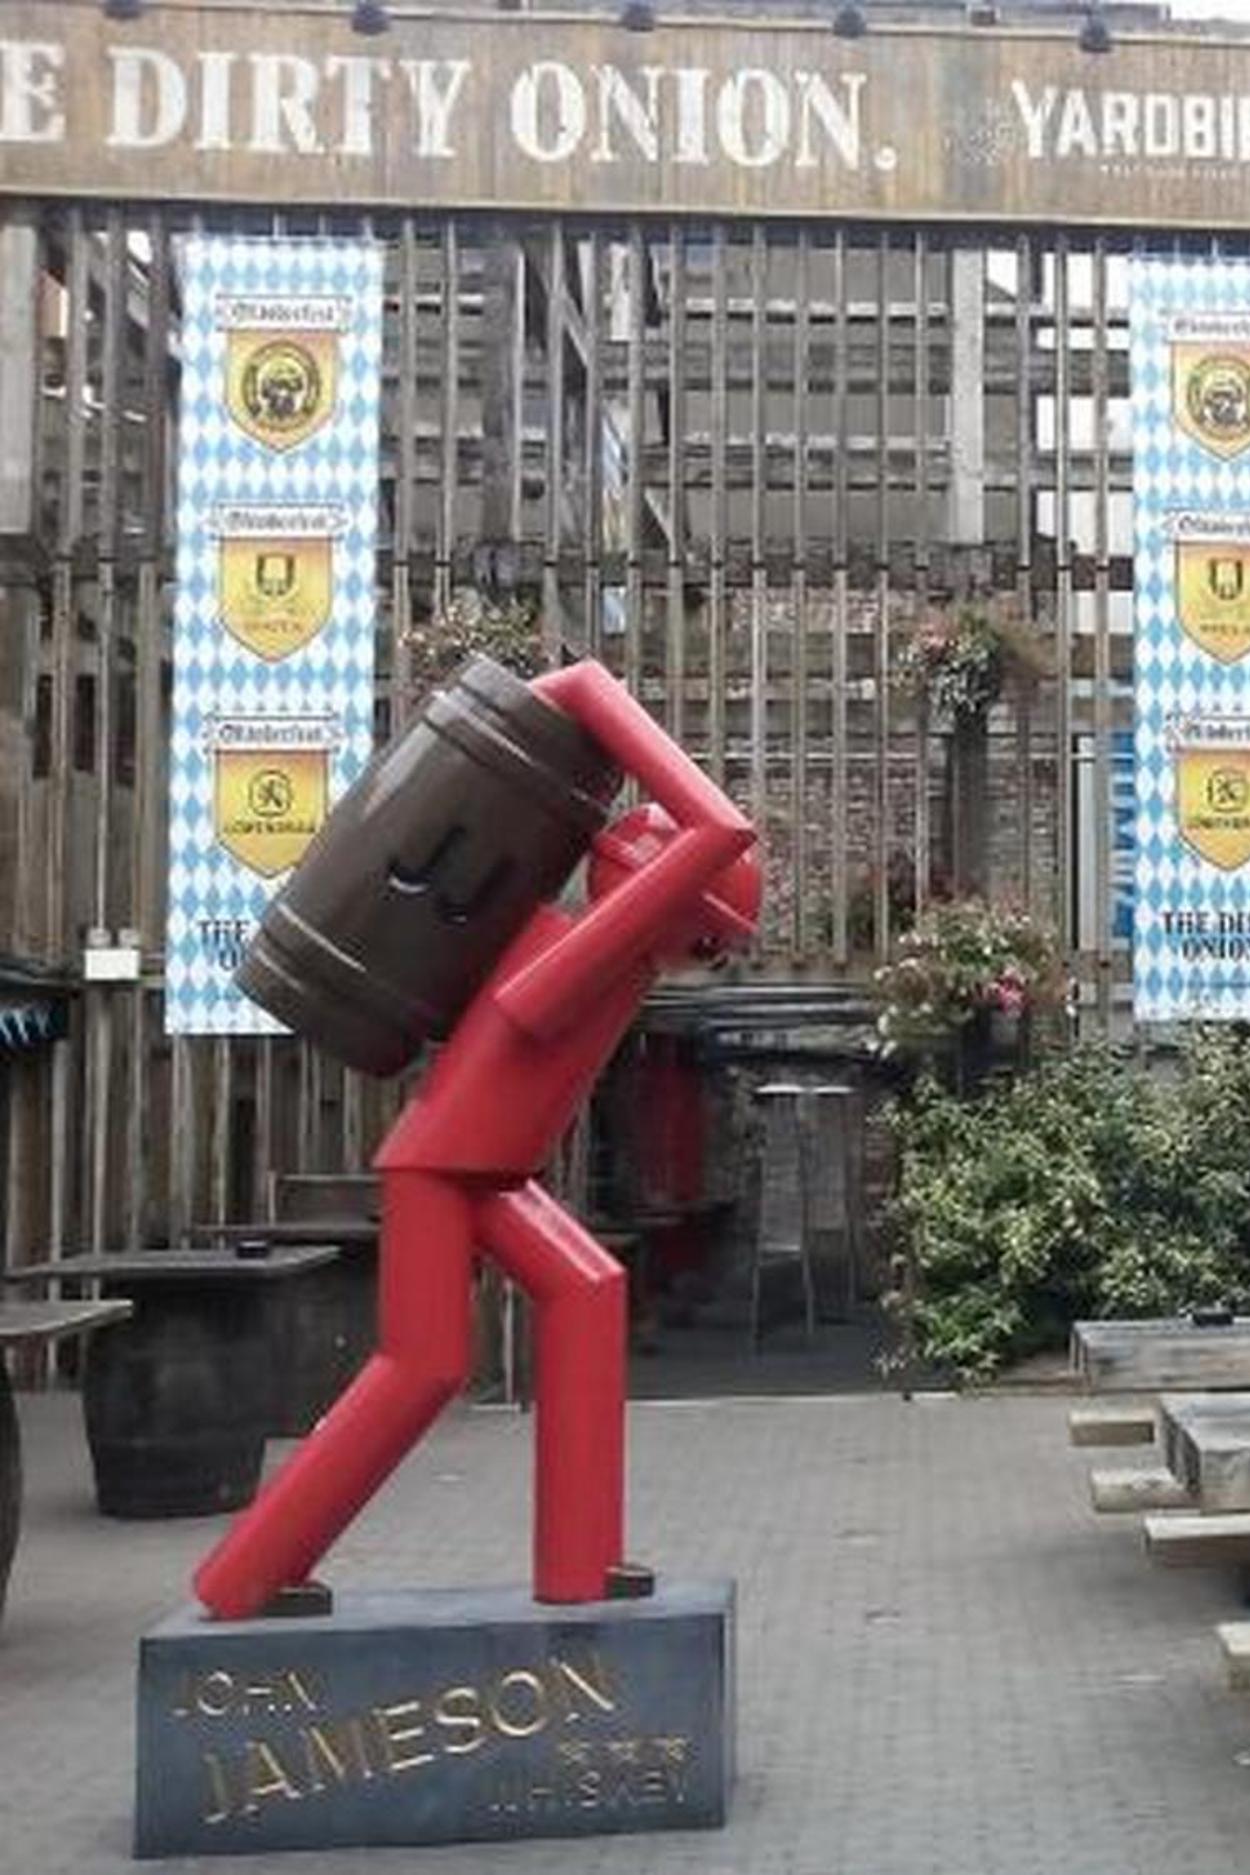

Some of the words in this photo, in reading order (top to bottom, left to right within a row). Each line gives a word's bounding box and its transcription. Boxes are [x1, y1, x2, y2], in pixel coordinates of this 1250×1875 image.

[105, 46, 471, 158] DIRTY
[510, 61, 897, 171] ONION.
[196, 919, 252, 945] THE
[1162, 911, 1209, 935] THE
[202, 1655, 618, 1823] JAMESON
